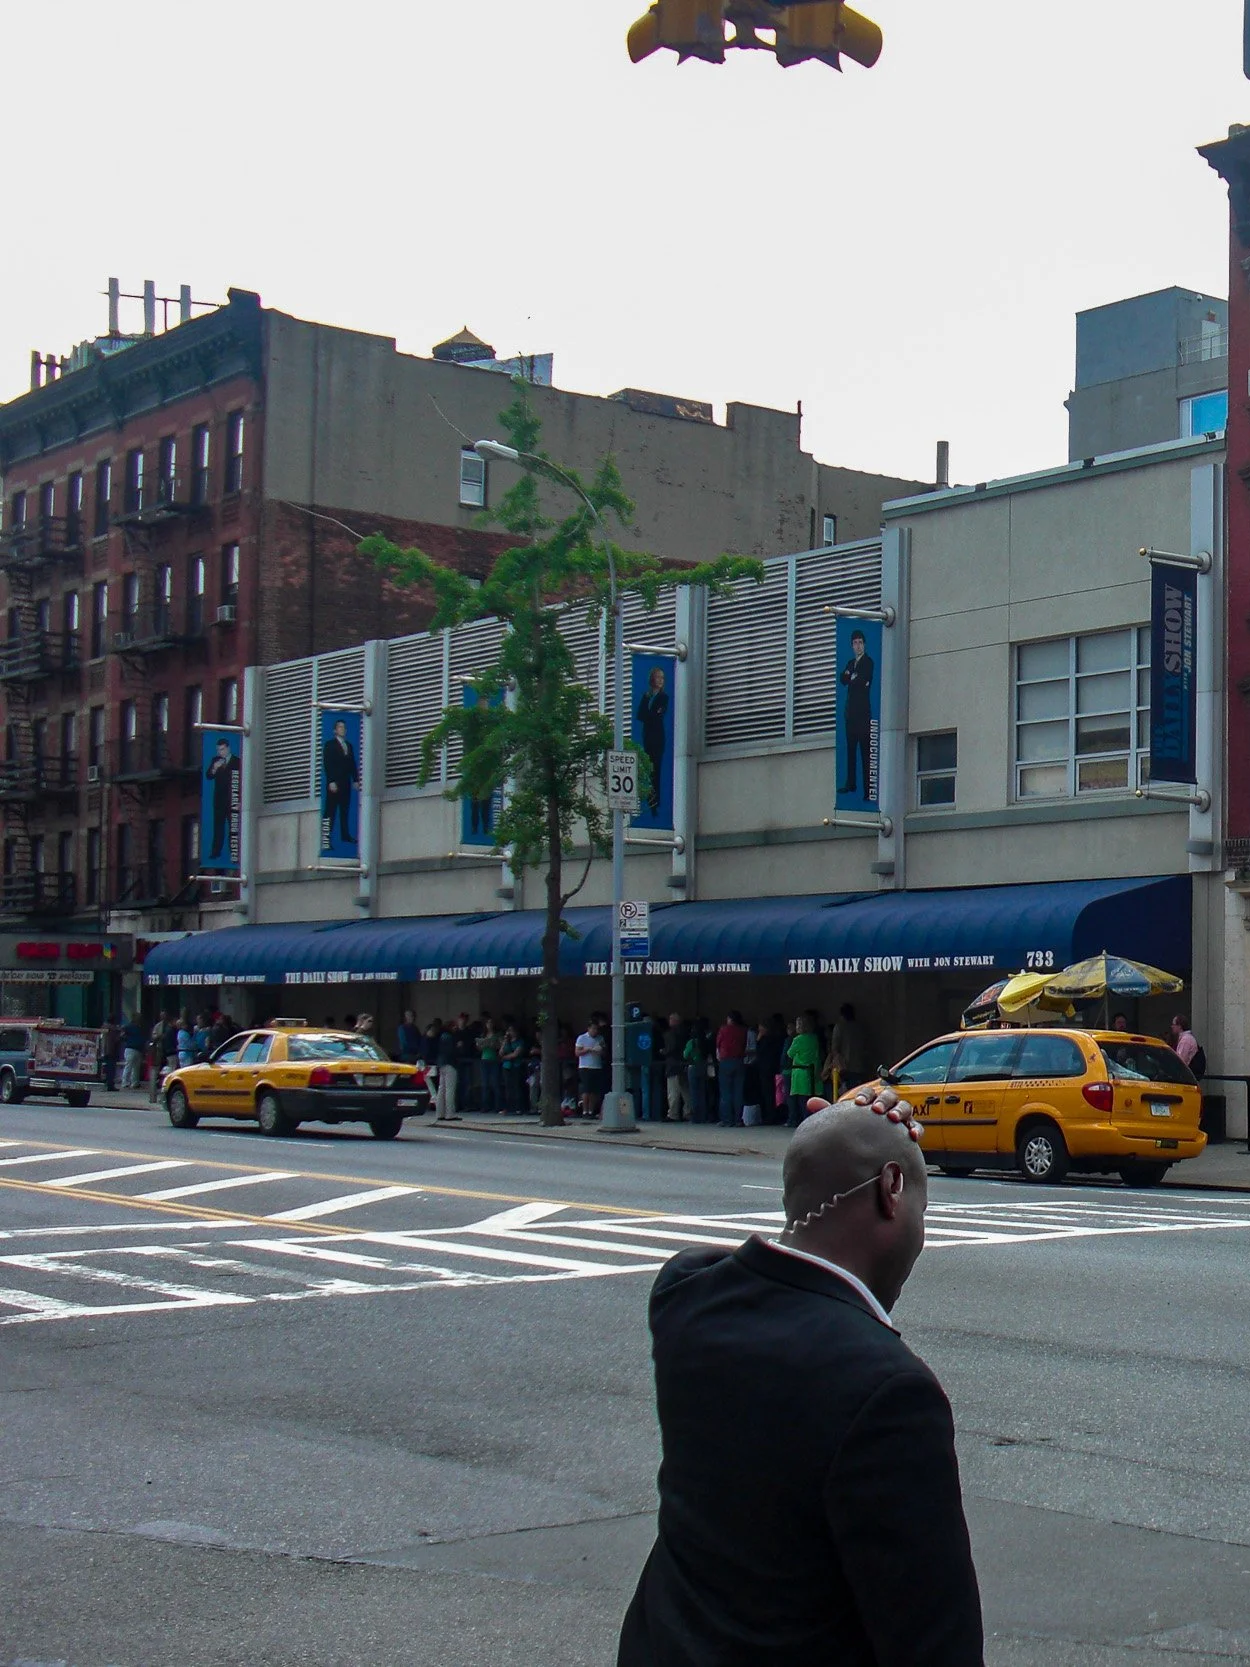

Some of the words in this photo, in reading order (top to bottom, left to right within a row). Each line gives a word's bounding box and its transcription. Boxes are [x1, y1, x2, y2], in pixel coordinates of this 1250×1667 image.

[1163, 583, 1182, 674] SHOW
[1183, 595, 1192, 647] STEWART
[1183, 649, 1192, 673] JON
[1162, 672, 1182, 758] DAILY
[609, 754, 635, 764] SPEED
[869, 719, 879, 801] UNDOCUMENTED
[612, 765, 632, 774] LIMIT
[611, 775, 634, 793] 30
[321, 817, 331, 849] BIPEDAL
[585, 961, 607, 975] THE
[645, 960, 678, 975] SHOW
[680, 963, 700, 973] WITH
[701, 963, 716, 973] JON
[717, 962, 751, 973] STEWART
[788, 959, 816, 974] THE
[820, 958, 861, 974] DAILY
[864, 956, 904, 972] SHOW
[907, 957, 930, 968] WITH
[934, 957, 951, 967] JON
[953, 955, 995, 967] STEWART
[1026, 950, 1054, 968] 733
[167, 974, 181, 985] THE
[182, 973, 203, 985] DAILY
[204, 973, 224, 985] SHOW
[285, 972, 301, 984] THE
[302, 971, 326, 984] DAILY
[327, 970, 350, 983] SHOW
[419, 968, 438, 981] THE
[440, 967, 469, 981] DAILY
[470, 966, 498, 980] SHOW
[499, 967, 516, 977] WITH
[517, 967, 529, 976] JON
[632, 1007, 640, 1018] P
[912, 1103, 931, 1117] AXI
